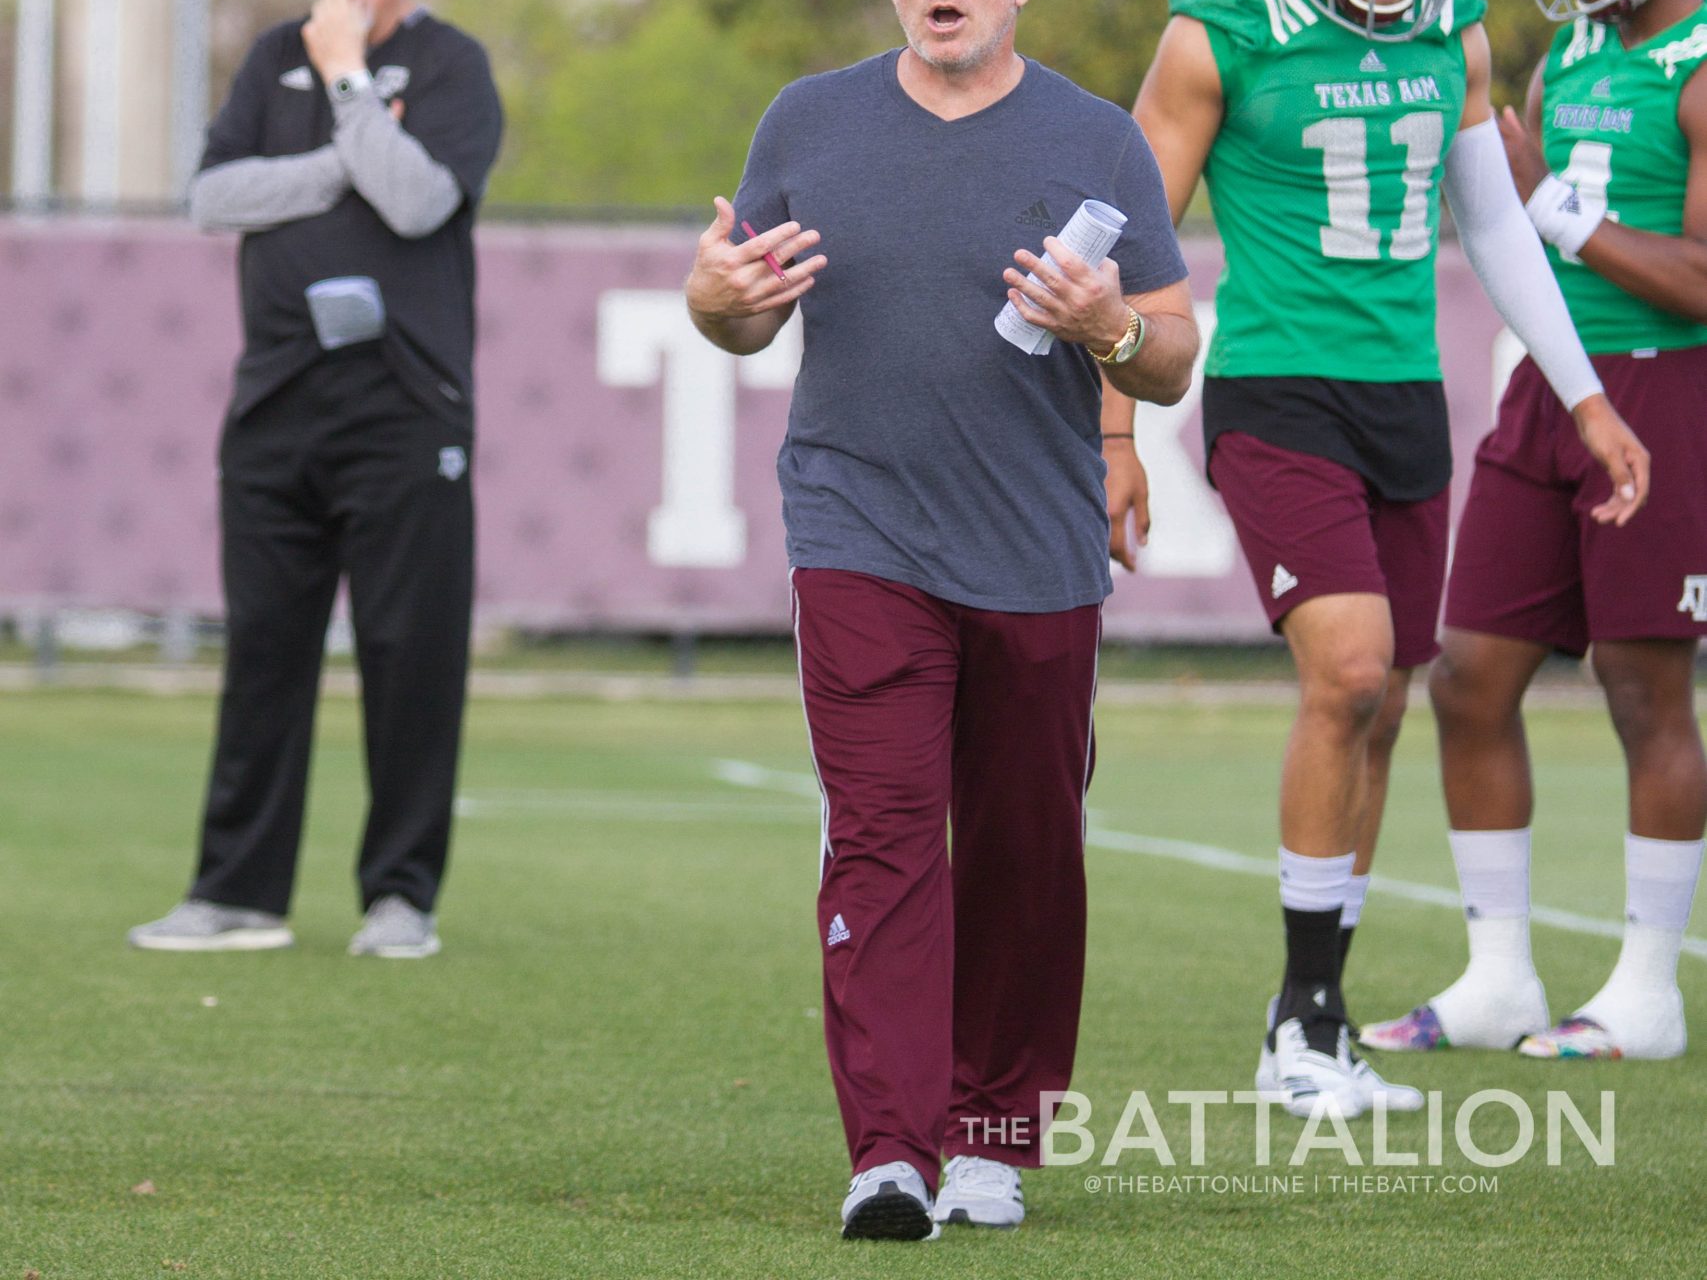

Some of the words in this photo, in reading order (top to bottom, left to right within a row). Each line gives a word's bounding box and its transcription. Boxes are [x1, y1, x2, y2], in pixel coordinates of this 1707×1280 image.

[1314, 81, 1391, 109] TEXAS
[1397, 75, 1441, 103] A&M
[1553, 103, 1599, 130] TEXAS
[1302, 111, 1444, 260] 11
[1014, 215, 1058, 231] adidas
